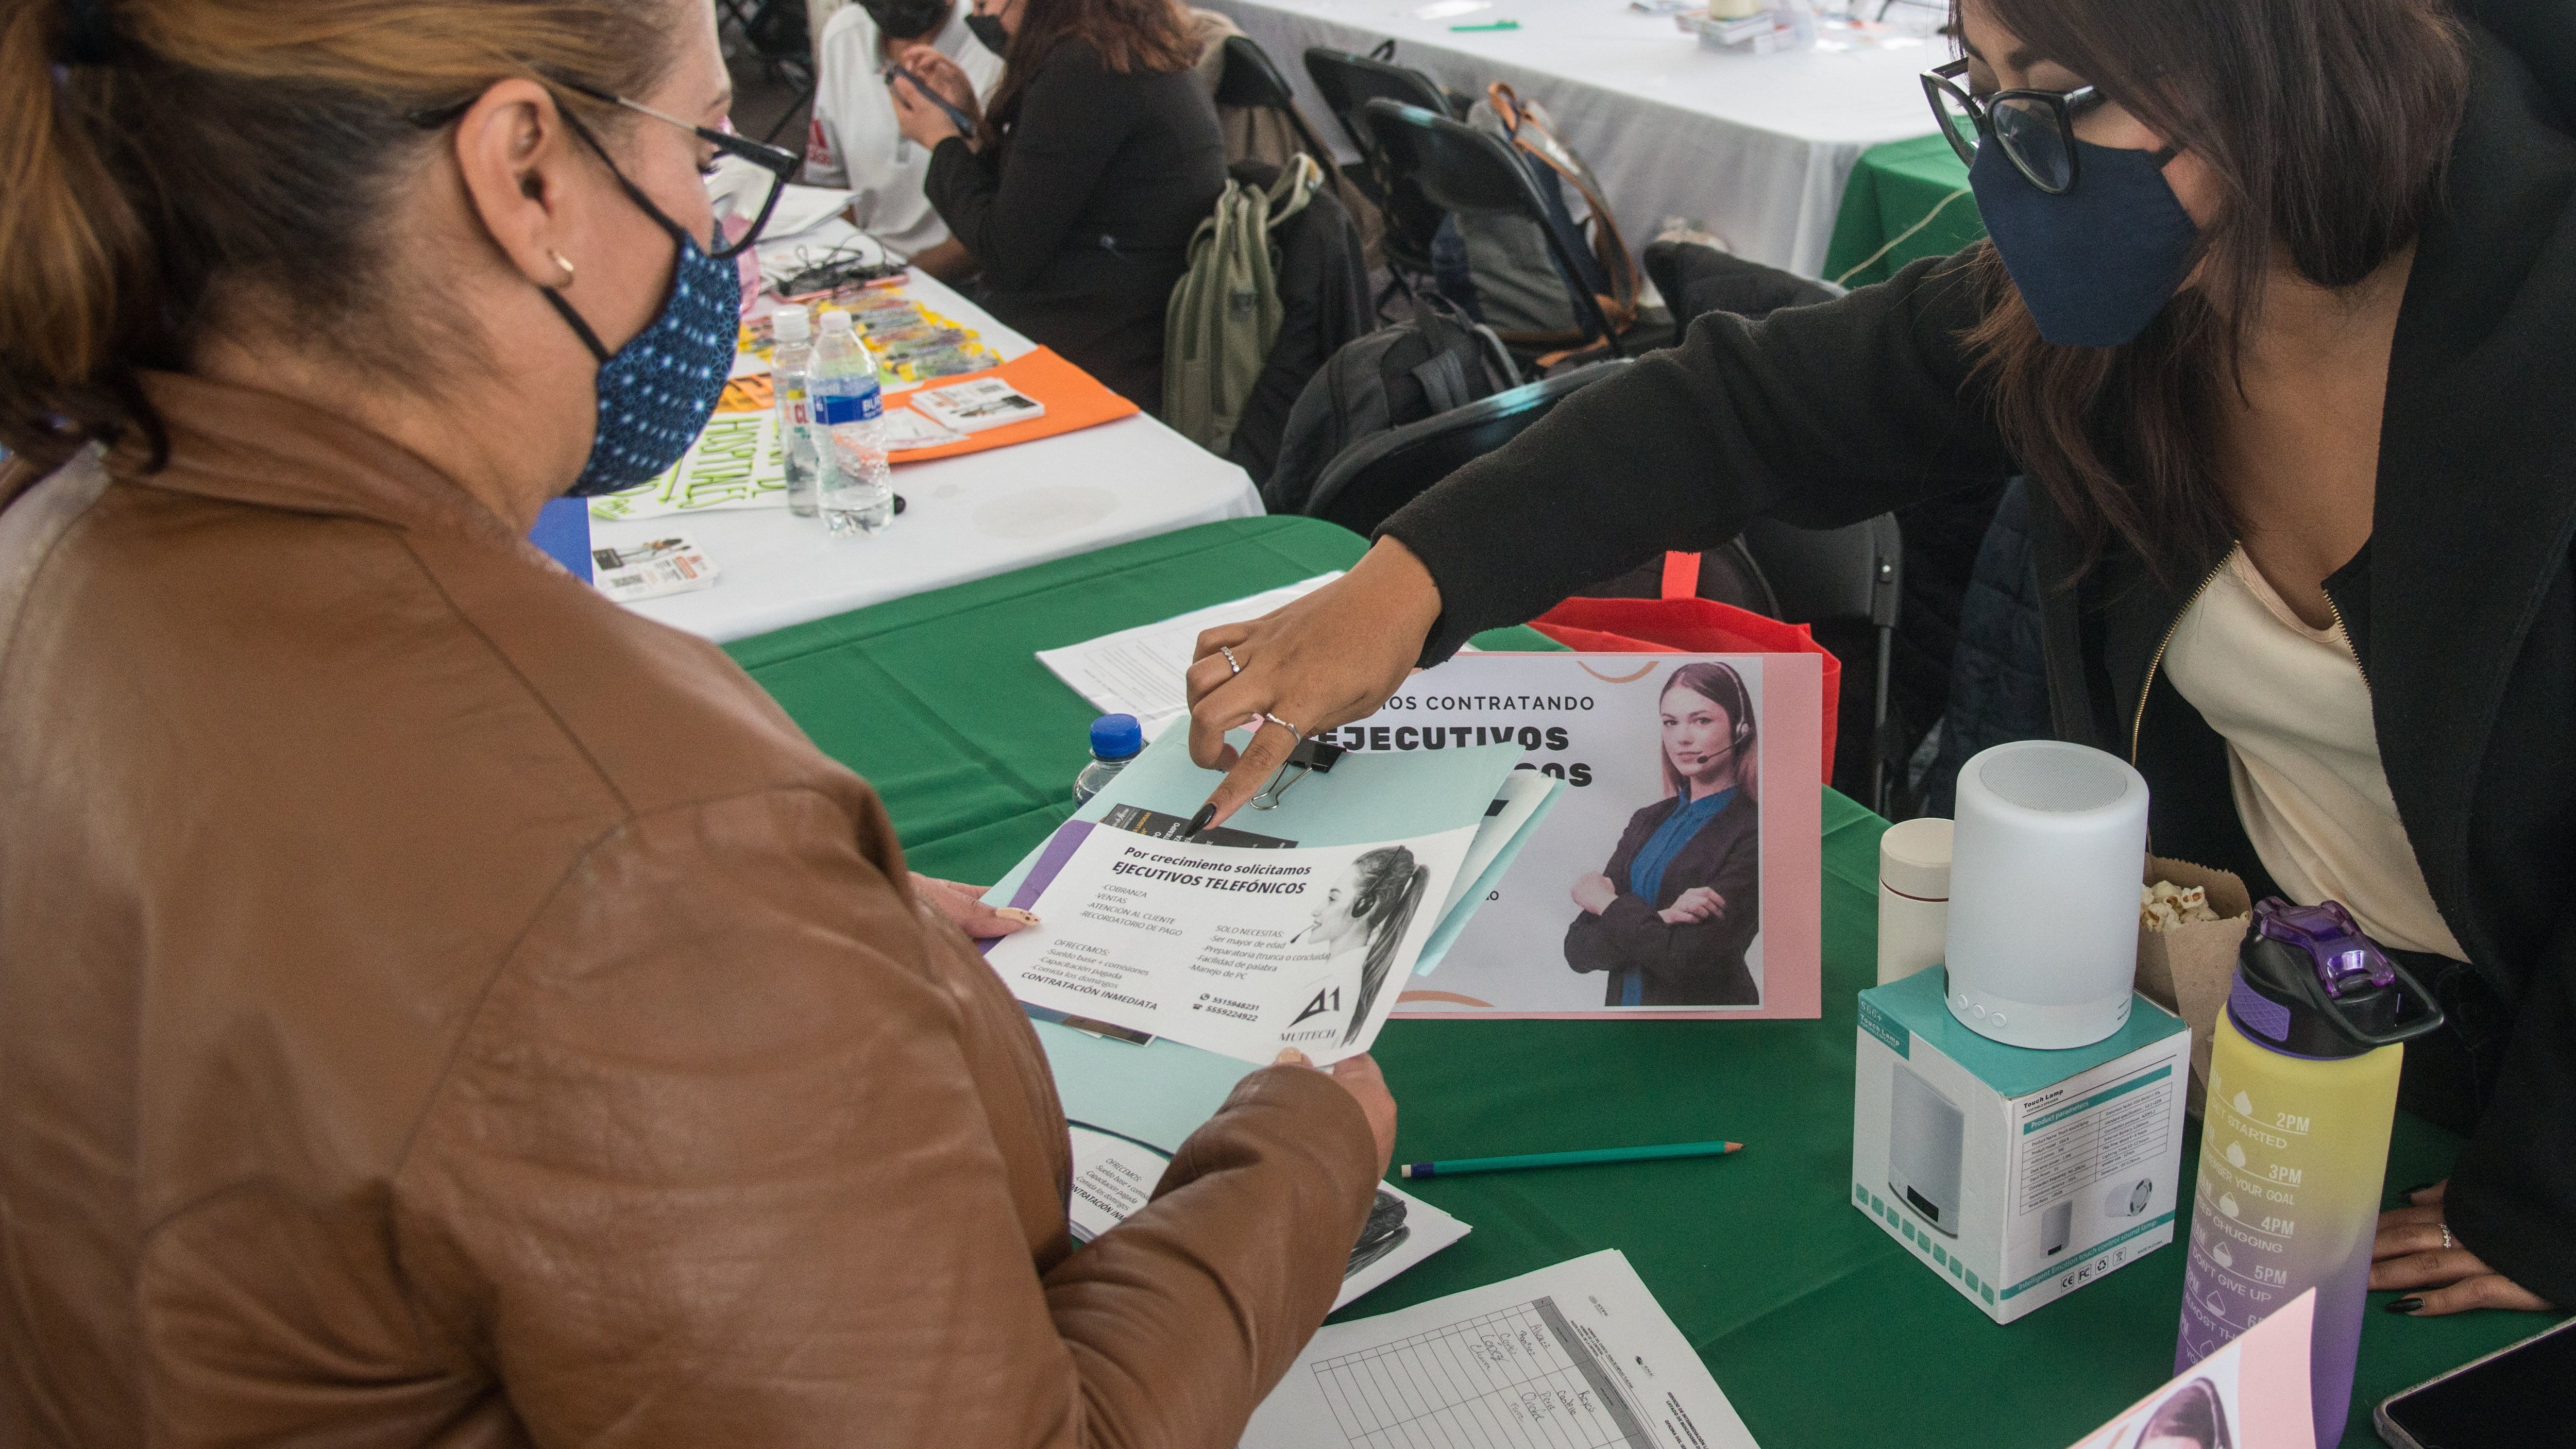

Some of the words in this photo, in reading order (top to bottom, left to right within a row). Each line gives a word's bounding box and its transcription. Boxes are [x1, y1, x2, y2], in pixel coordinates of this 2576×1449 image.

[1382, 696, 1417, 710] OS
[1426, 696, 1595, 711] CONTRATANDO
[1124, 847, 1149, 858] Por
[1150, 852, 1232, 872] crecimiento
[1234, 864, 1312, 875] solicitamos
[1112, 861, 1204, 887] EJECUTIVOS
[1205, 878, 1307, 895] TELEFÓNICOS
[1143, 913, 1177, 924] CLIENTE
[1159, 927, 1182, 936] PAGO
[1215, 925, 1239, 934] SOLO
[1240, 929, 1284, 938] NECESITAS:
[1055, 939, 1110, 956] OFRECEMOS:
[1226, 937, 1253, 949] mayor
[1077, 955, 1096, 964] base
[1104, 961, 1150, 975] comisiones
[1246, 962, 1278, 972] palabra
[1256, 953, 1283, 961] (trunca
[1292, 953, 1331, 962] concluida)
[1078, 974, 1119, 989] domingos
[1092, 968, 1123, 980] pagada
[1022, 972, 1100, 996] CONTRATACIÓN
[1101, 990, 1158, 1010] INMEDIATA
[1861, 1001, 1882, 1021] S66+
[1860, 1014, 1880, 1032] Touch
[1882, 1029, 1900, 1046] Lamp
[2024, 1097, 2044, 1108] Touch
[2045, 1089, 2063, 1100] Lamp
[2031, 1115, 2055, 1128] Product
[2056, 1101, 2089, 1121] parameters
[2276, 1112, 2310, 1132] 2PM
[2228, 1115, 2287, 1149] STARTED
[1114, 1176, 1128, 1186] base
[2269, 1164, 2302, 1184] 3PM
[1070, 1184, 1113, 1213] ONTRATACIÓN
[1117, 1190, 1138, 1204] pagada
[2235, 1176, 2262, 1198] YOUR
[2266, 1189, 2295, 1205] GOAL
[1104, 1193, 1130, 1211] domingos
[2213, 1216, 2283, 1253] CHUGGING
[2261, 1216, 2294, 1235] 4PM
[2019, 1269, 2050, 1290] Intelligent
[2052, 1256, 2078, 1272] Emotion
[2079, 1248, 2097, 1262] touch
[2098, 1235, 2120, 1254] control
[2121, 1227, 2140, 1240] sound
[2140, 1220, 2157, 1232] lamp
[2193, 1246, 2216, 1277] DON'T
[2218, 1274, 2247, 1295] GIVE
[2250, 1288, 2272, 1302] UP
[2254, 1265, 2287, 1285] 5PM
[1664, 1419, 1677, 1436] OFICINA
[1666, 1400, 1678, 1416] LISTADO
[1680, 1421, 1698, 1446] BUSCADORES
[1667, 1391, 1680, 1408] SERVICIO
[1681, 1412, 1706, 1446] INTERMEDIACIÓN
